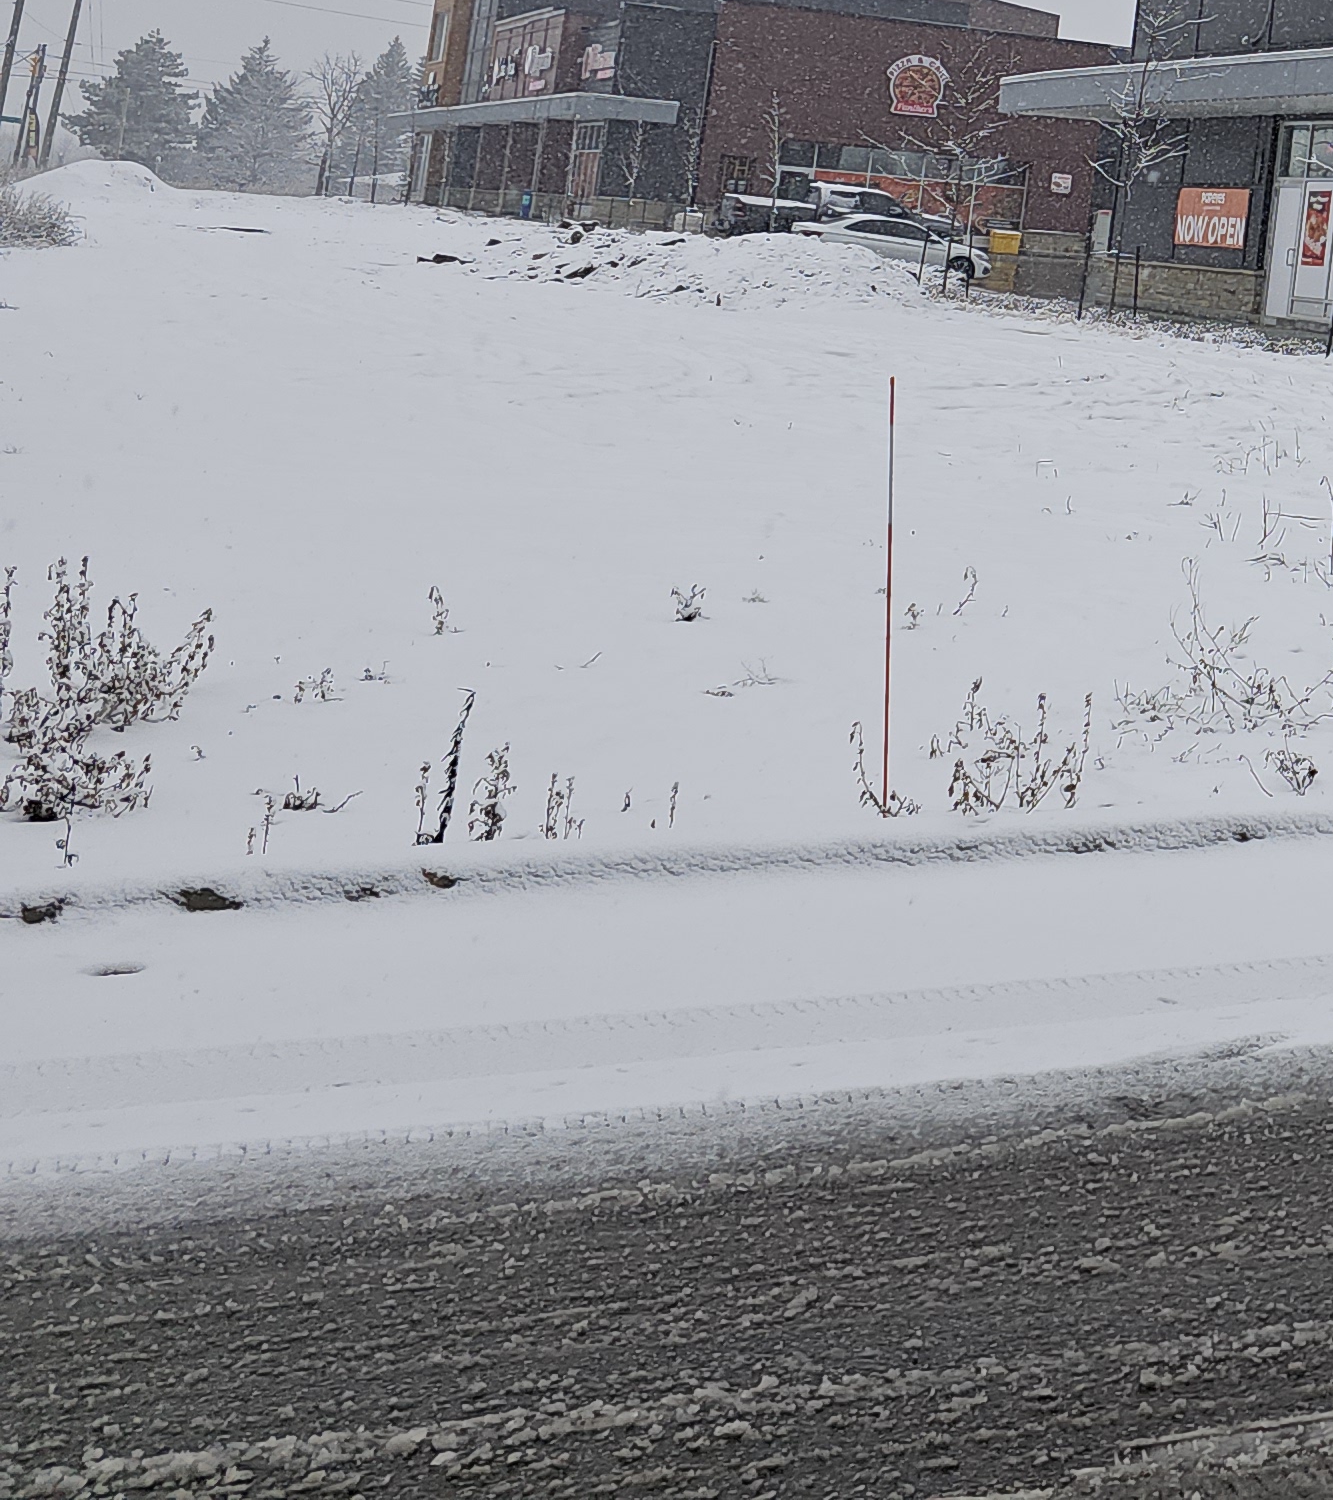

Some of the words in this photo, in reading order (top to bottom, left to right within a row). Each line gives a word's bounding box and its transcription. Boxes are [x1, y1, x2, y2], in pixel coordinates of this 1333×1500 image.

[889, 57, 912, 76] PIZZA
[1178, 214, 1208, 243] NOW
[1208, 216, 1246, 247] OPEN
